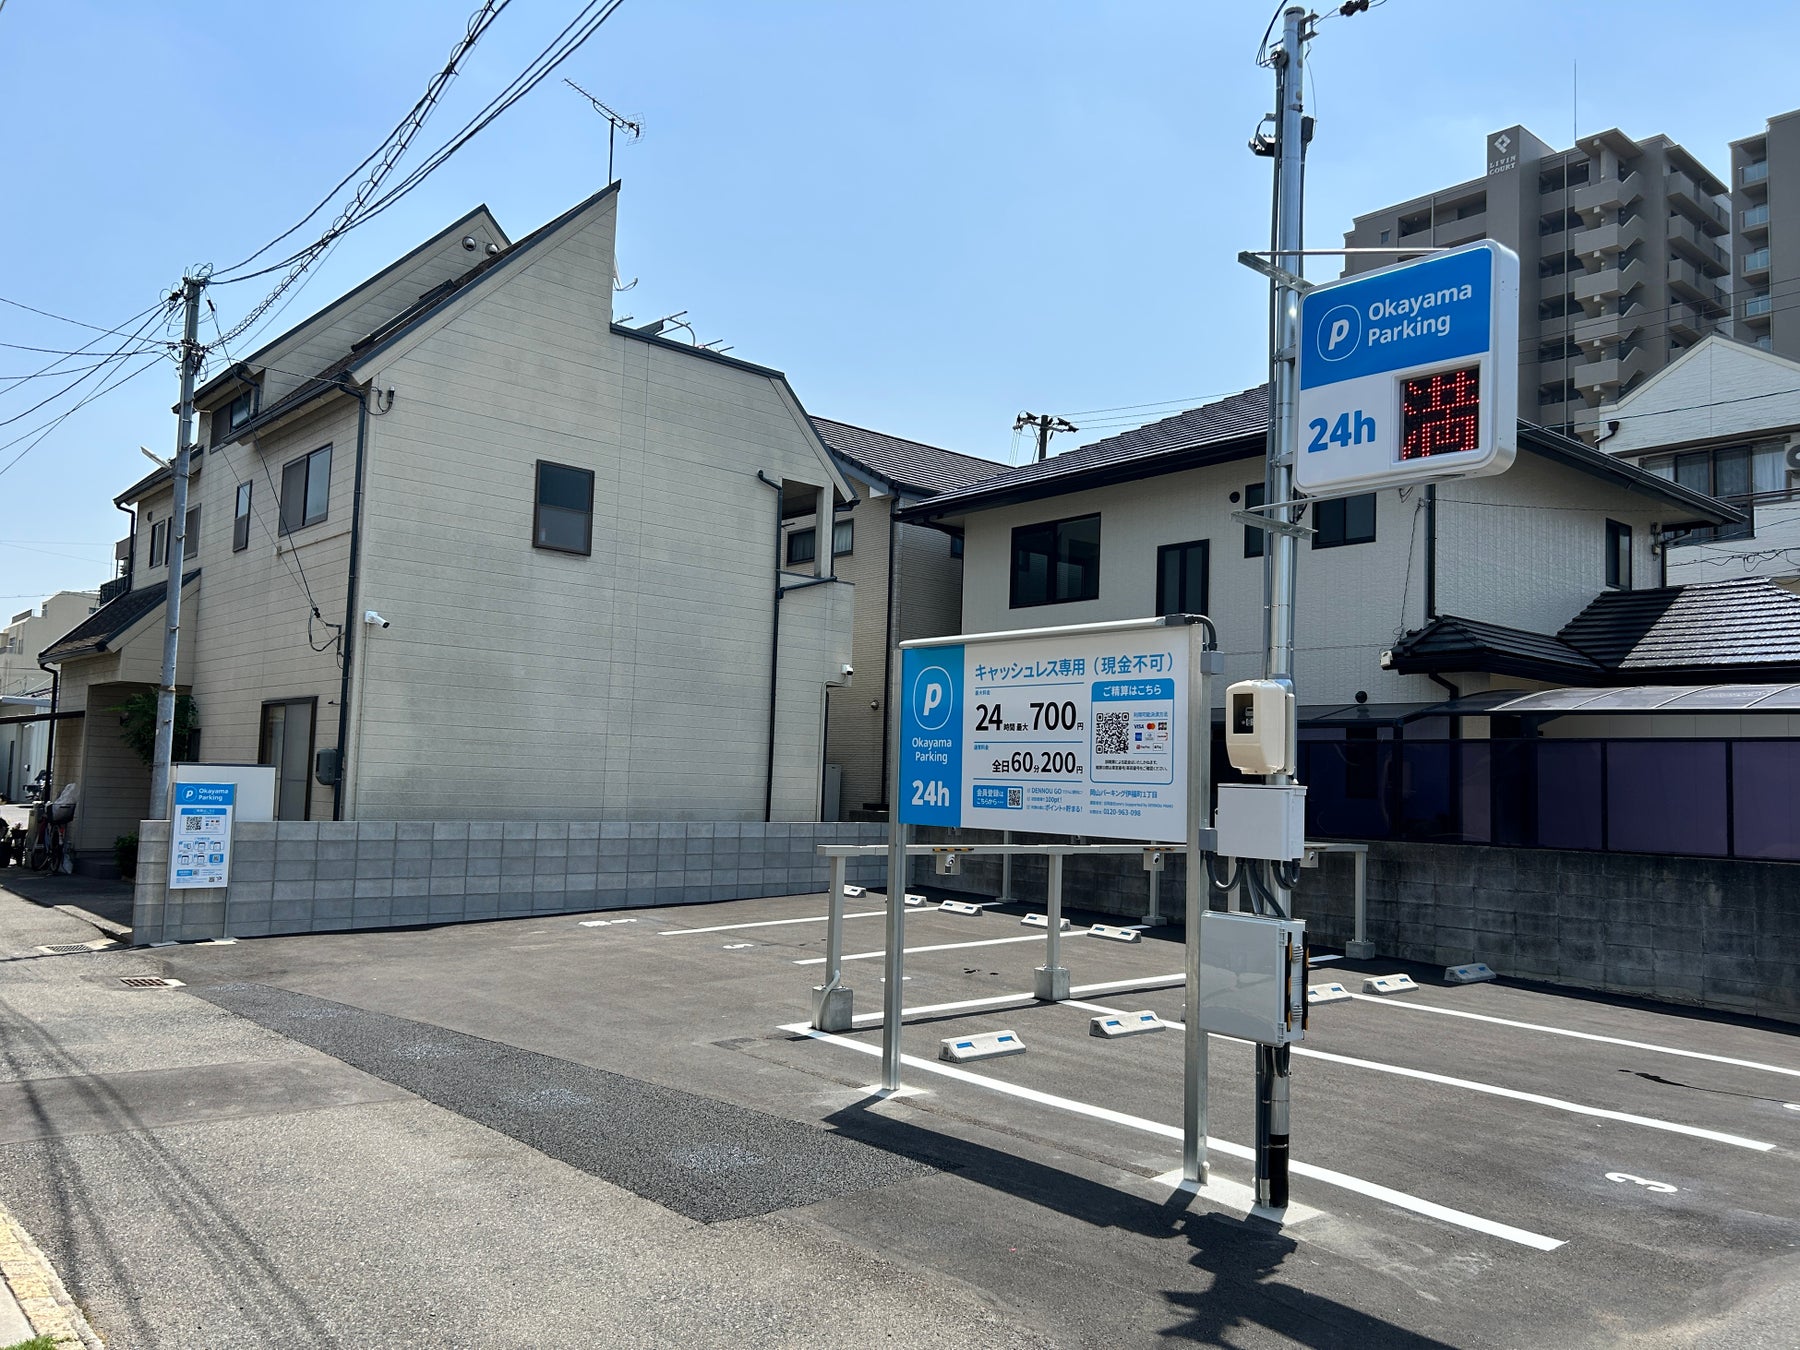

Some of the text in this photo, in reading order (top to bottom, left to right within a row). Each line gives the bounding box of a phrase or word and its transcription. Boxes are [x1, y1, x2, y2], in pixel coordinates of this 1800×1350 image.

[1489, 155, 1516, 168] LIVIN
[1489, 162, 1516, 175] COURT
[1368, 283, 1473, 321] Okayama
[1368, 314, 1451, 347] Parking
[1307, 409, 1376, 453] 24h
[1103, 684, 1162, 697] ご精算はこちら
[911, 737, 952, 750] Okayama
[915, 751, 948, 764] Parking
[198, 788, 229, 796] Okayama
[911, 779, 950, 807] 24h
[1031, 787, 1053, 795] DENNOU
[1053, 787, 1062, 795] GO
